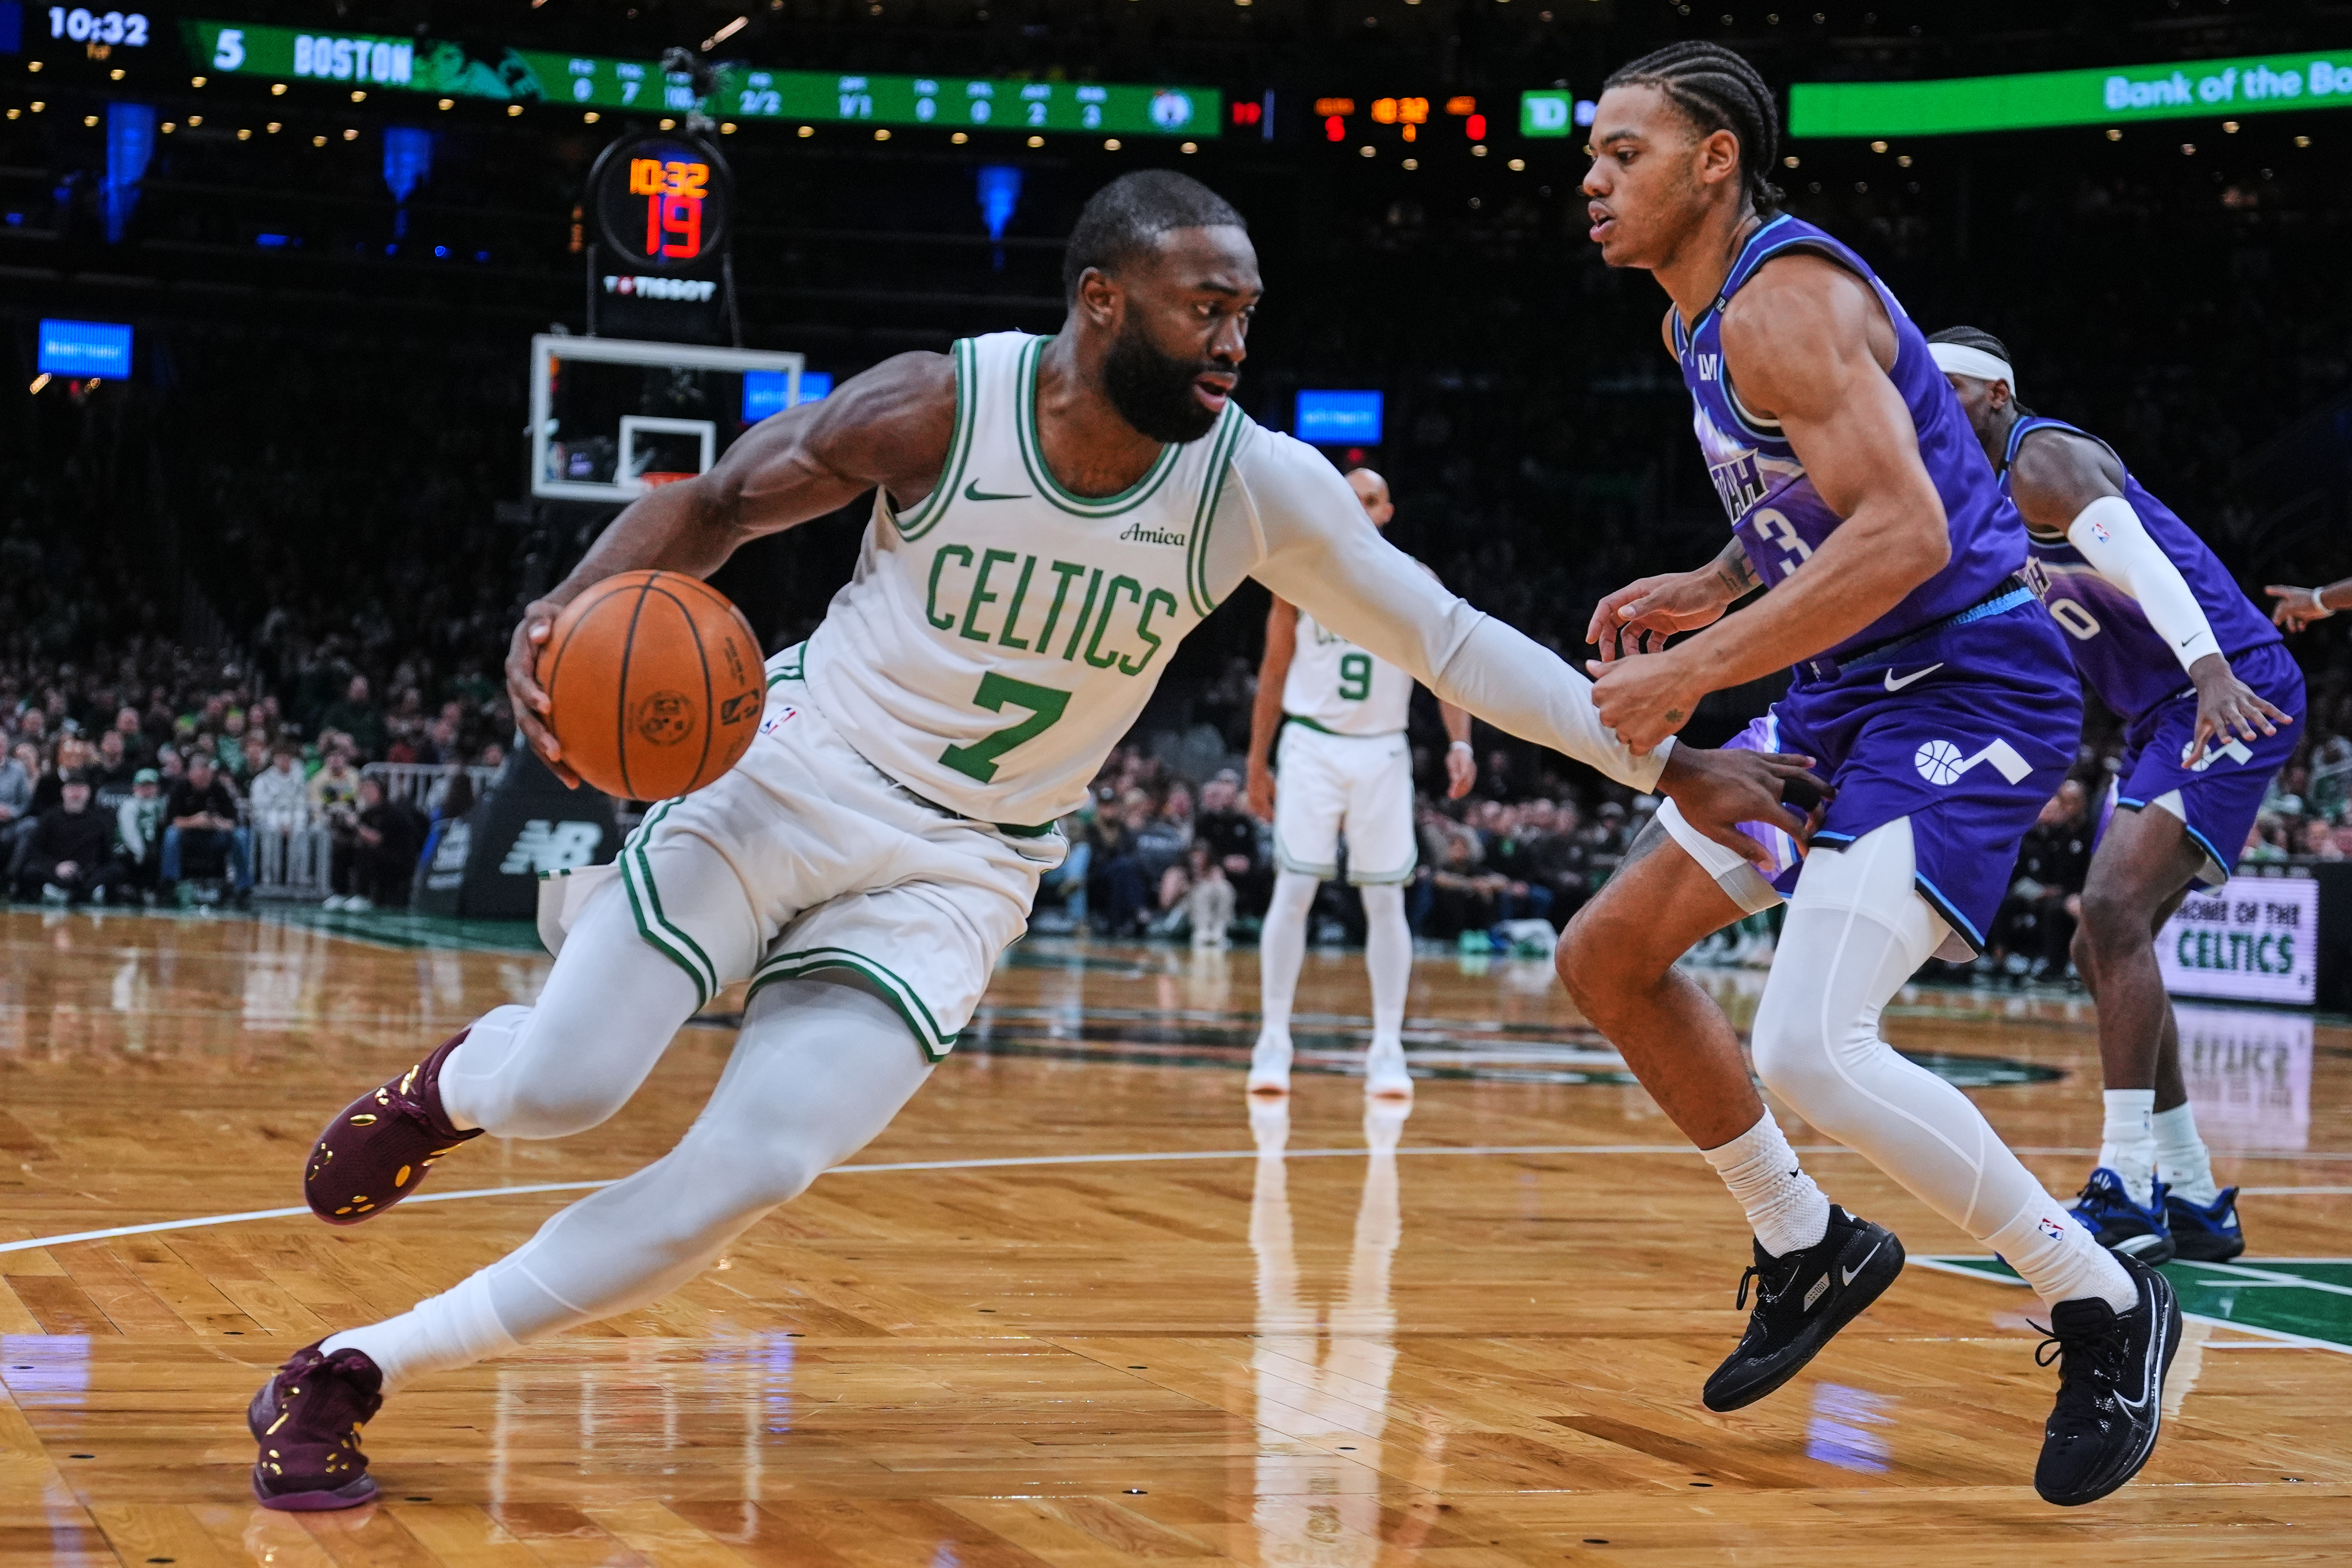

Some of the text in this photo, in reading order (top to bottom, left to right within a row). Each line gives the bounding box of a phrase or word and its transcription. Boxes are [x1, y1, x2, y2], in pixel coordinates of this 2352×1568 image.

[49, 7, 149, 47] 10:32
[213, 29, 414, 84] 5 BOSTON
[2105, 71, 2194, 110] Bank
[2198, 66, 2238, 103] of
[2243, 64, 2302, 100] the
[630, 158, 709, 199] 10:32
[646, 194, 702, 258] 19
[1120, 522, 1185, 546] Amica
[1753, 508, 1812, 576] 3
[926, 543, 1178, 676] CELTICS
[2049, 598, 2101, 640] 0
[1338, 652, 1372, 700] 9
[938, 671, 1072, 783] 7
[2178, 929, 2293, 974] CELTICS
